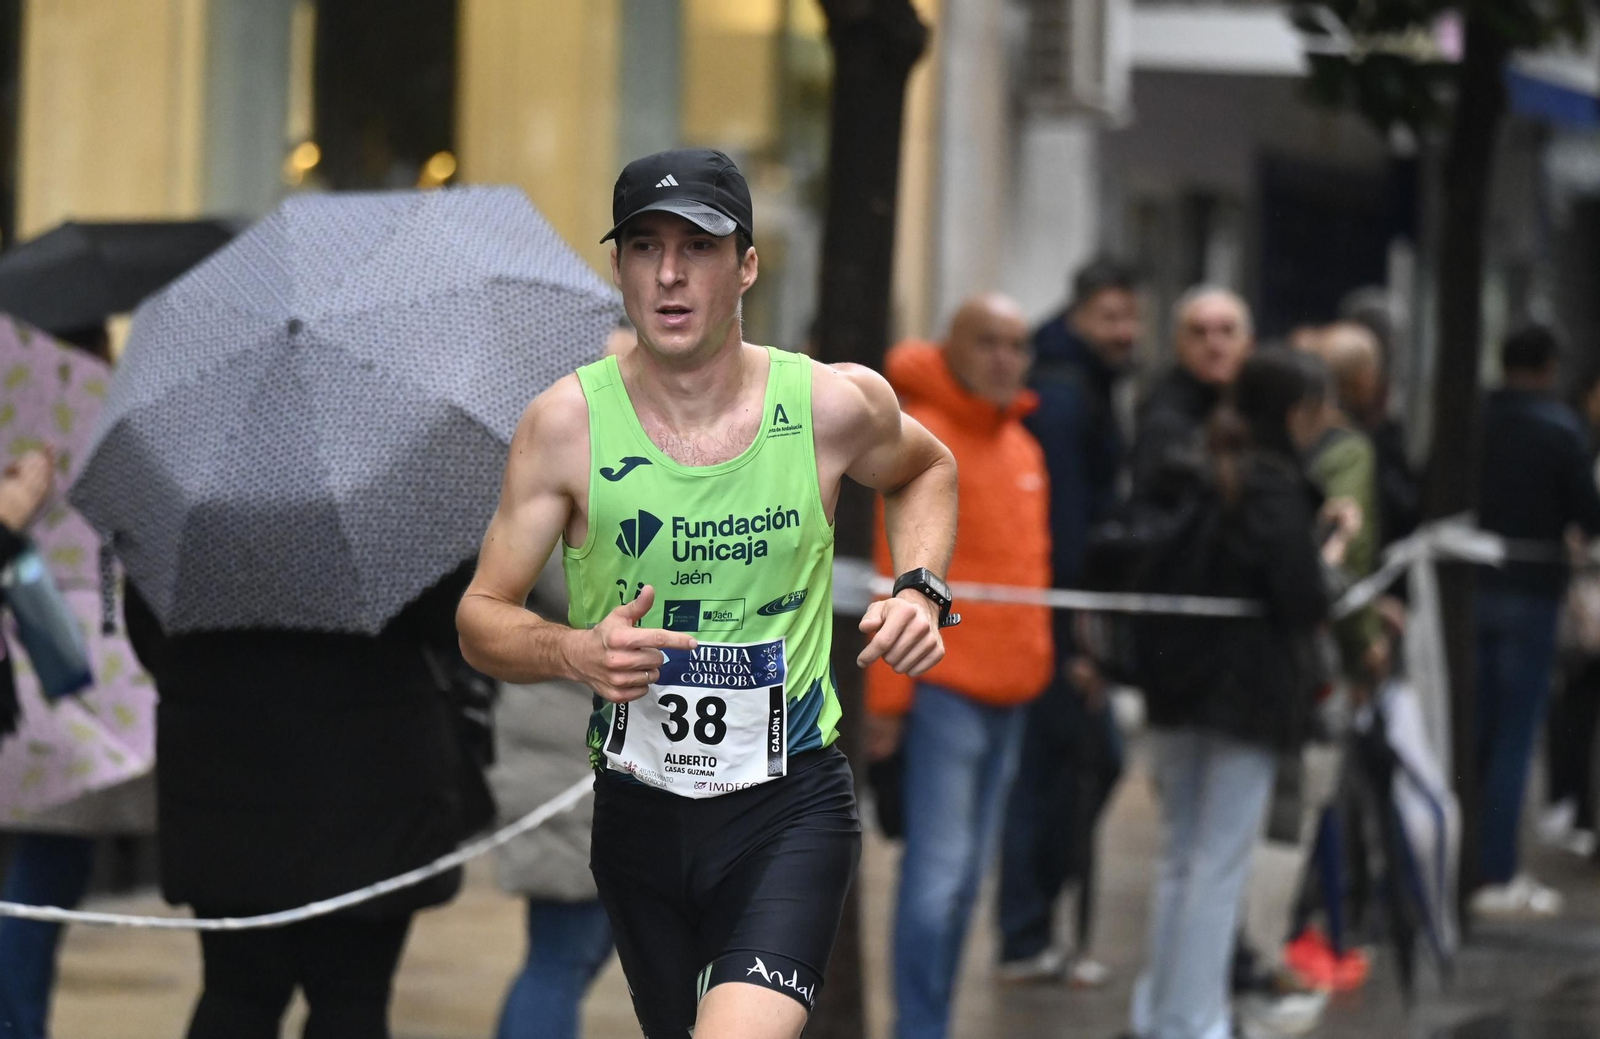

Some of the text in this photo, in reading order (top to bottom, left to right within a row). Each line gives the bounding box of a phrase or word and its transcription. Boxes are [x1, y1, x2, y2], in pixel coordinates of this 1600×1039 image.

[672, 505, 800, 538] Fundación
[672, 536, 768, 565] Unicaja
[670, 569, 712, 585] Jaén
[712, 610, 733, 619] Jaén
[688, 646, 751, 663] MEDIA
[617, 701, 626, 730] CAJÓ
[657, 693, 727, 745] 38
[771, 717, 780, 753] CAJÓN
[664, 752, 717, 768] ALBERTO
[664, 765, 715, 777] CASAS GUZMAN
